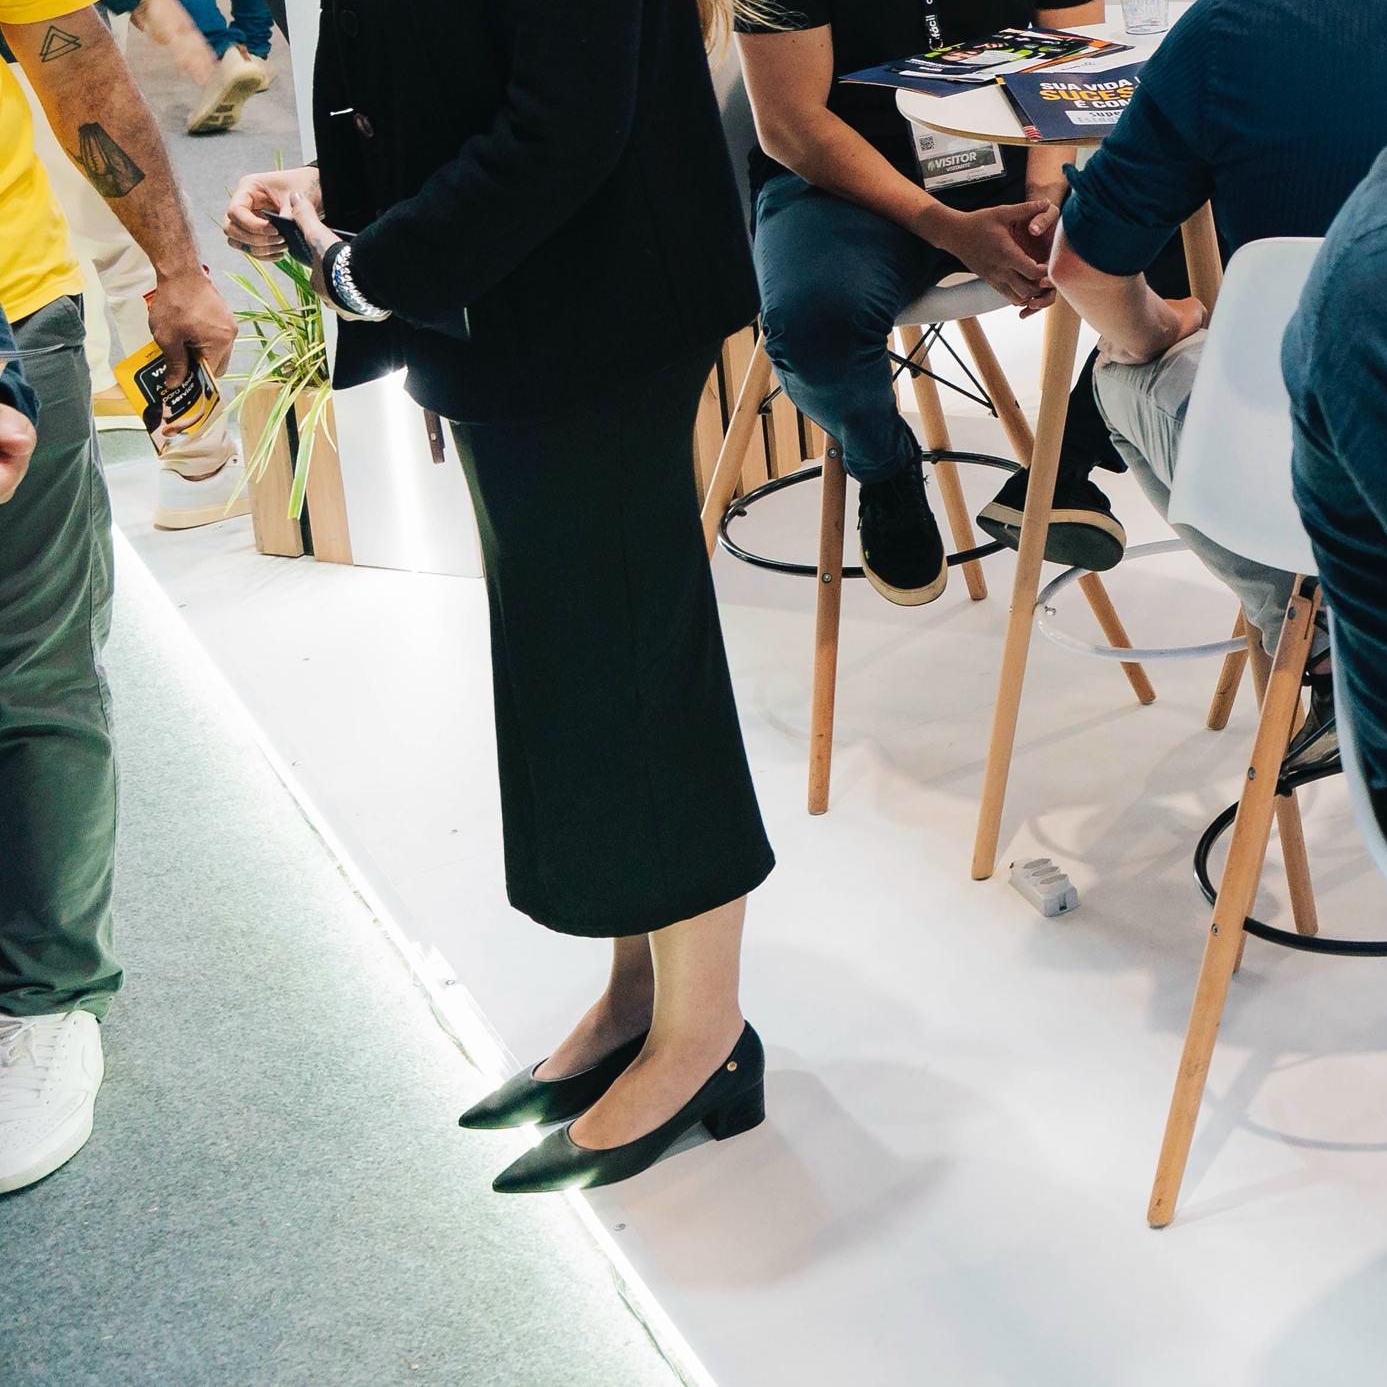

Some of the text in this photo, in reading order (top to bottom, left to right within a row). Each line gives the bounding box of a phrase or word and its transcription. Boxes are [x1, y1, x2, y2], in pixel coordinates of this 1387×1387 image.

[1039, 79, 1132, 91] SUA VIDA
[1074, 100, 1090, 108] É
[935, 151, 977, 168] VISITOR
[162, 389, 181, 403] para
[171, 382, 195, 405] service
